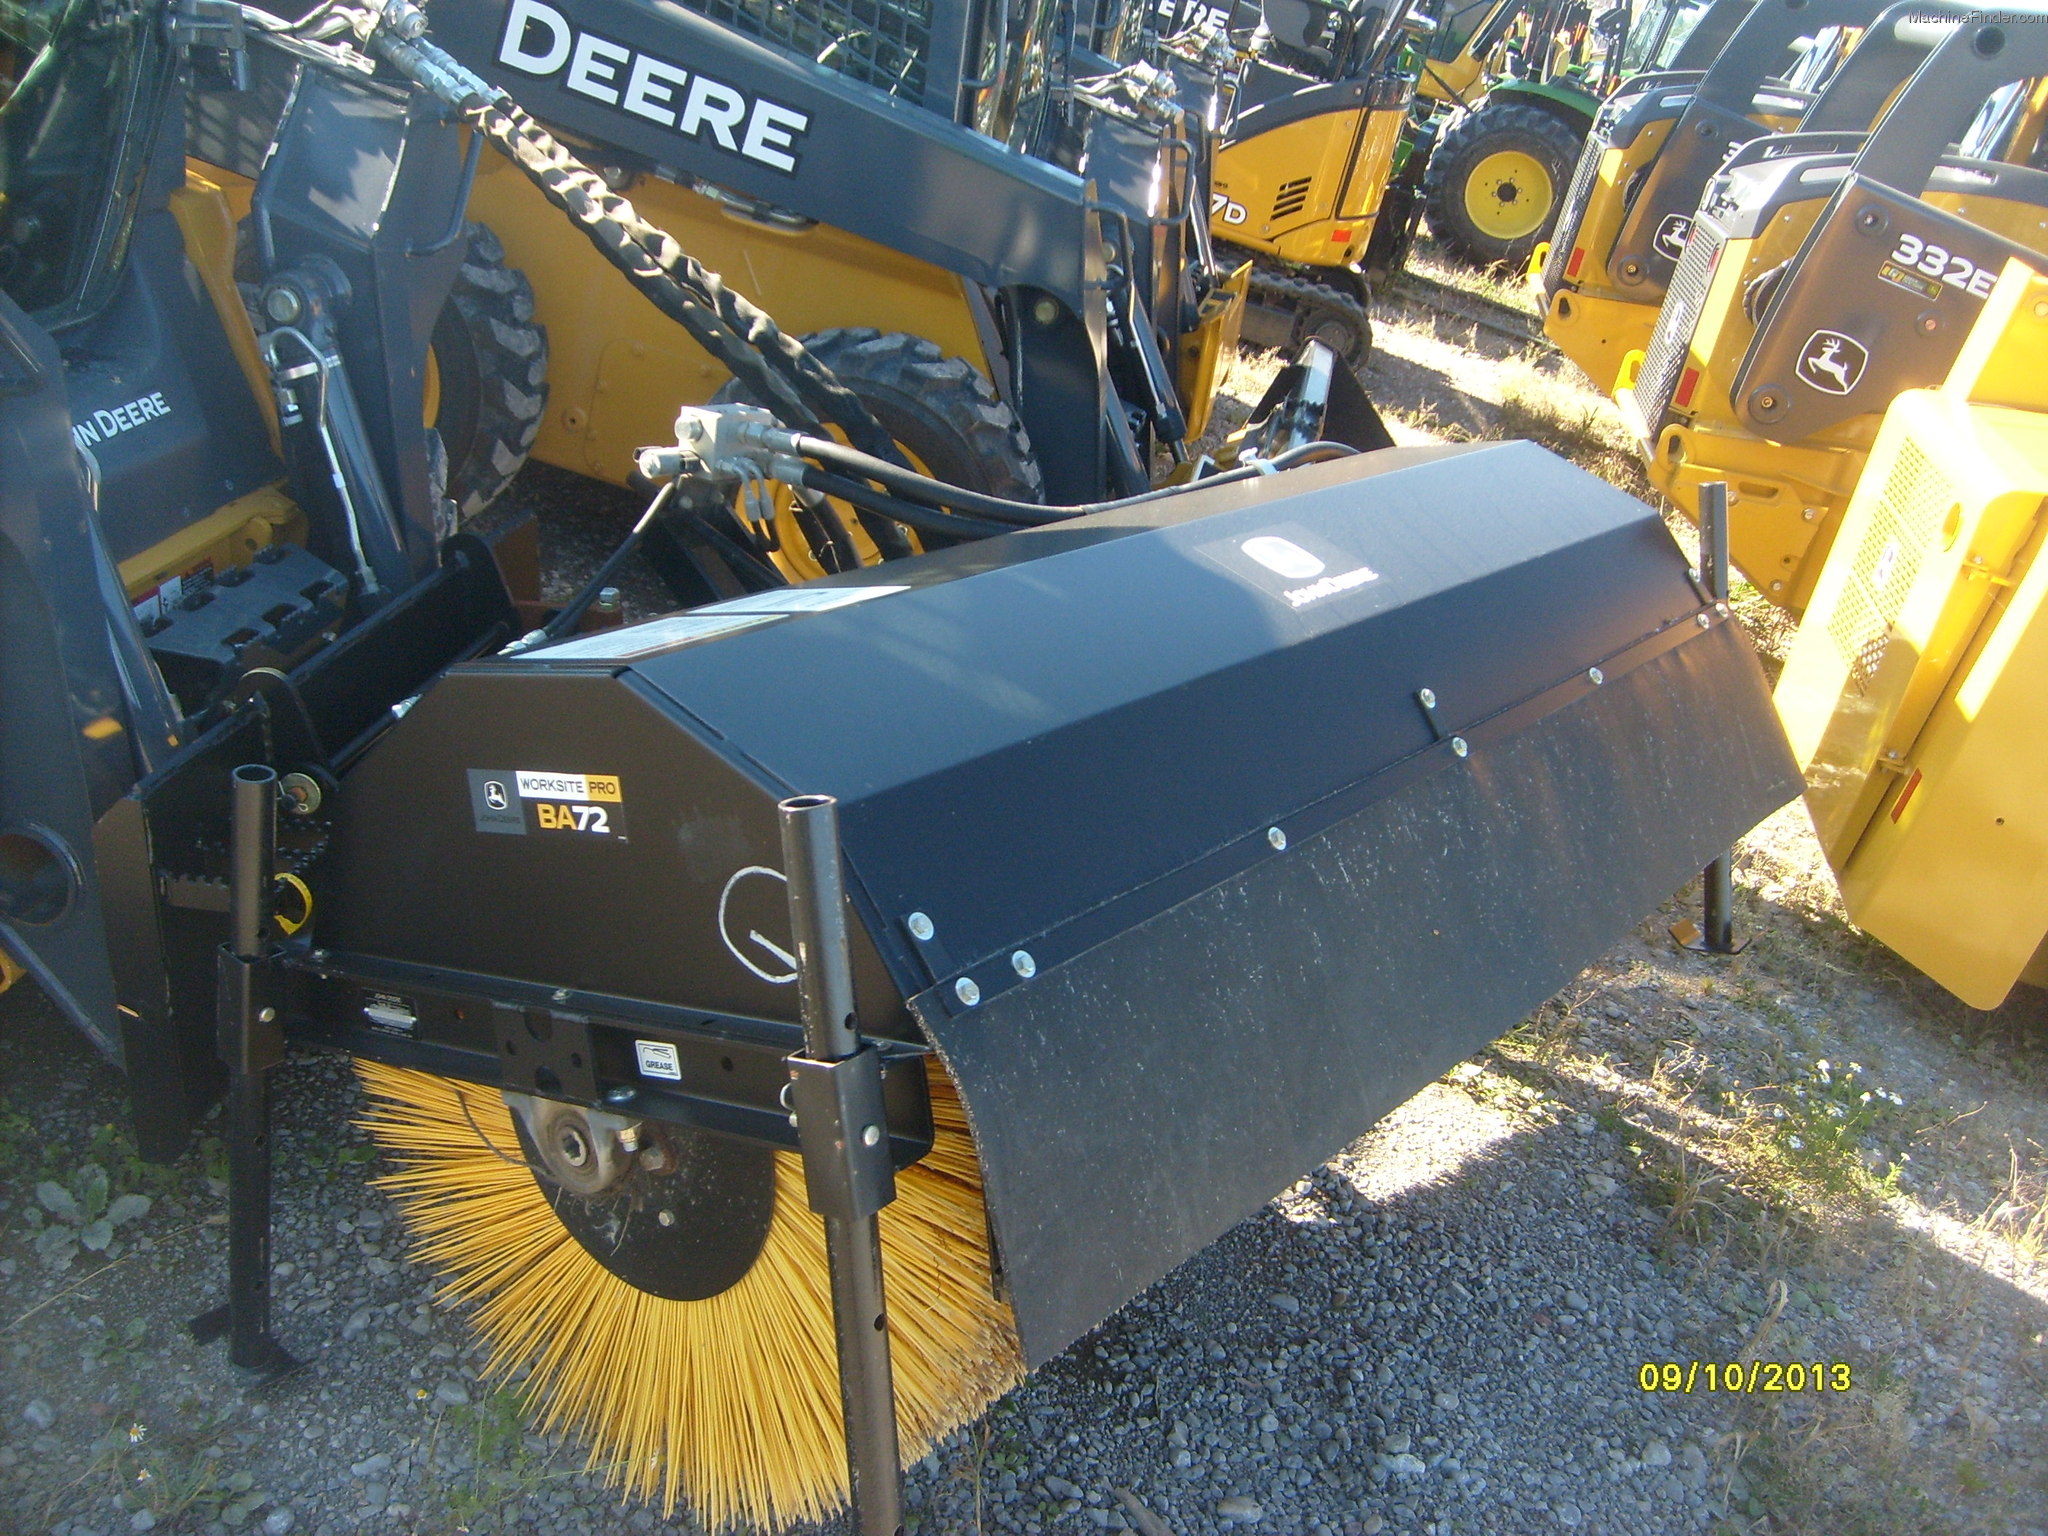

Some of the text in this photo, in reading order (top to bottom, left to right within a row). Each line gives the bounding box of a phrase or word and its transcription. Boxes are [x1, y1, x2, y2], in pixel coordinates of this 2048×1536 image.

[499, 0, 808, 172] DEERE
[1211, 192, 1248, 225] 7D
[1891, 233, 1999, 299] 332E
[93, 391, 171, 438] DEERE
[520, 777, 617, 795] WORKSITE PRO
[536, 803, 611, 833] BA72
[645, 1060, 674, 1071] GREASE
